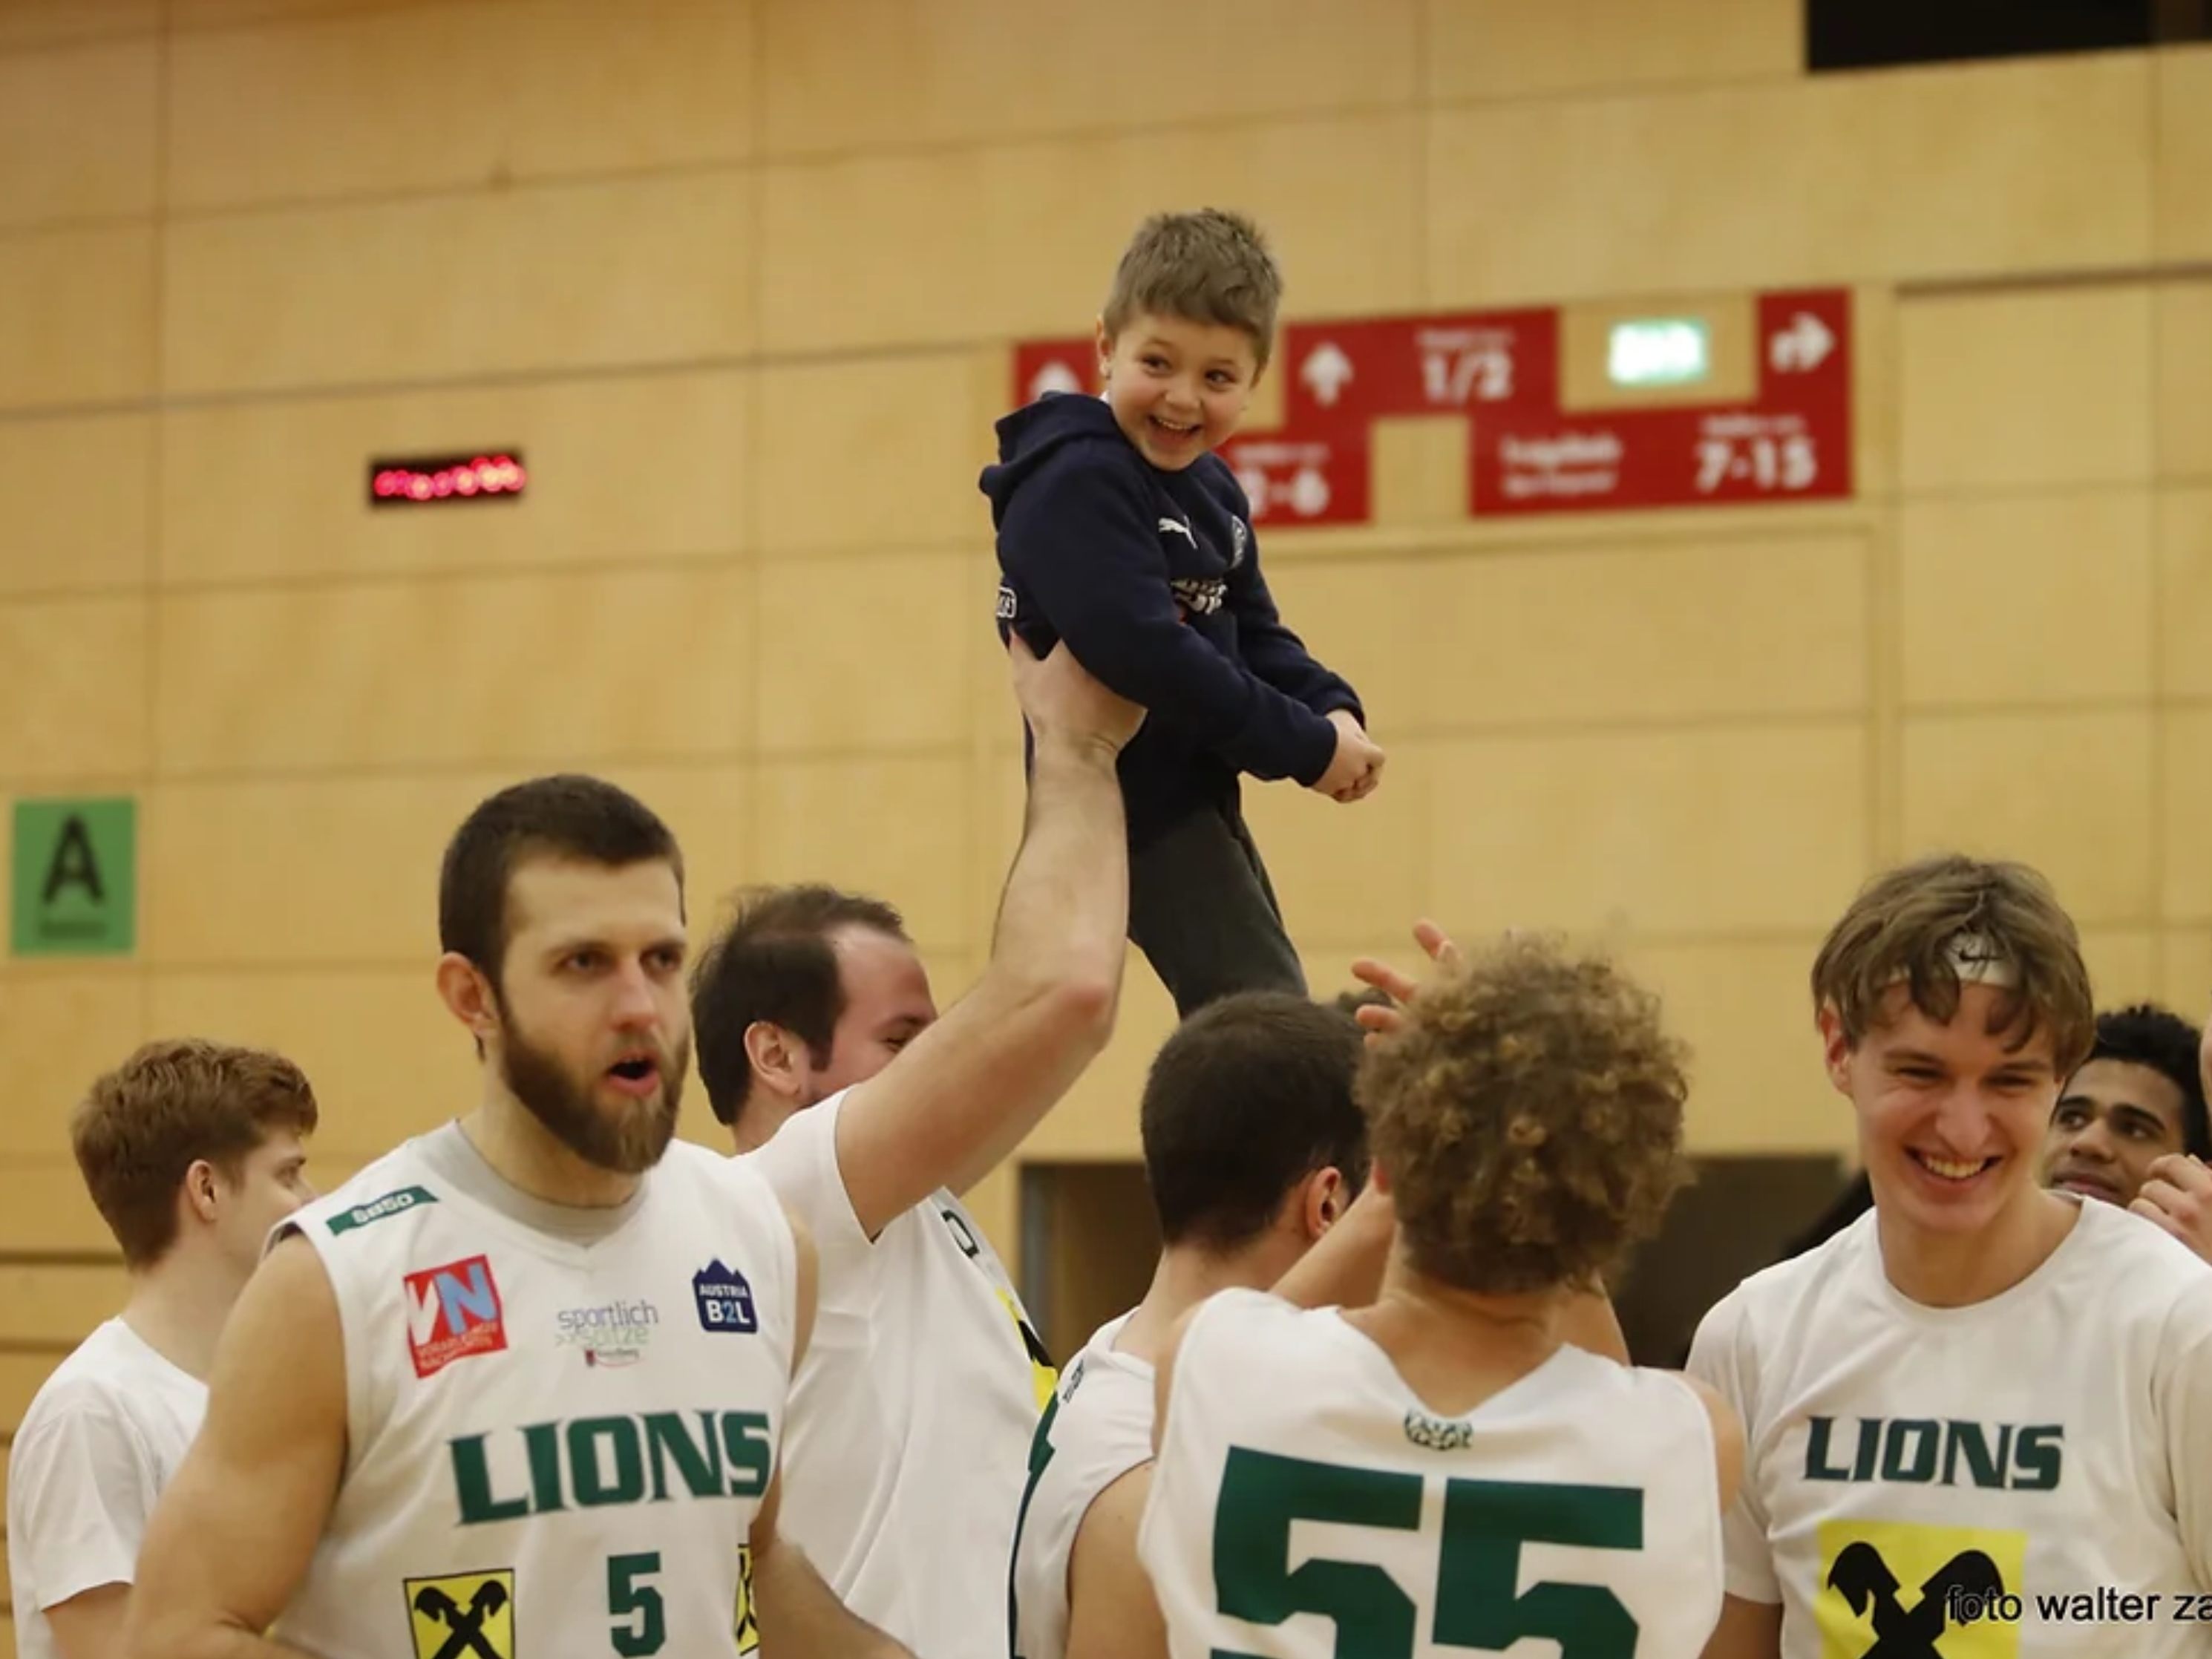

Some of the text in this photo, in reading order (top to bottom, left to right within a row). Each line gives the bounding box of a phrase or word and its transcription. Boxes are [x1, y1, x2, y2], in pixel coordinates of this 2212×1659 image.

[42, 814, 105, 907] A
[407, 1263, 497, 1346] VN
[557, 1299, 658, 1335] sportlich
[698, 1284, 749, 1298] AUSTRIA
[705, 1299, 750, 1324] B2L
[447, 1410, 771, 1527] LIONS
[1803, 1416, 2065, 1491] LIONS
[1211, 1444, 1645, 1659] 55
[606, 1551, 667, 1659] 5
